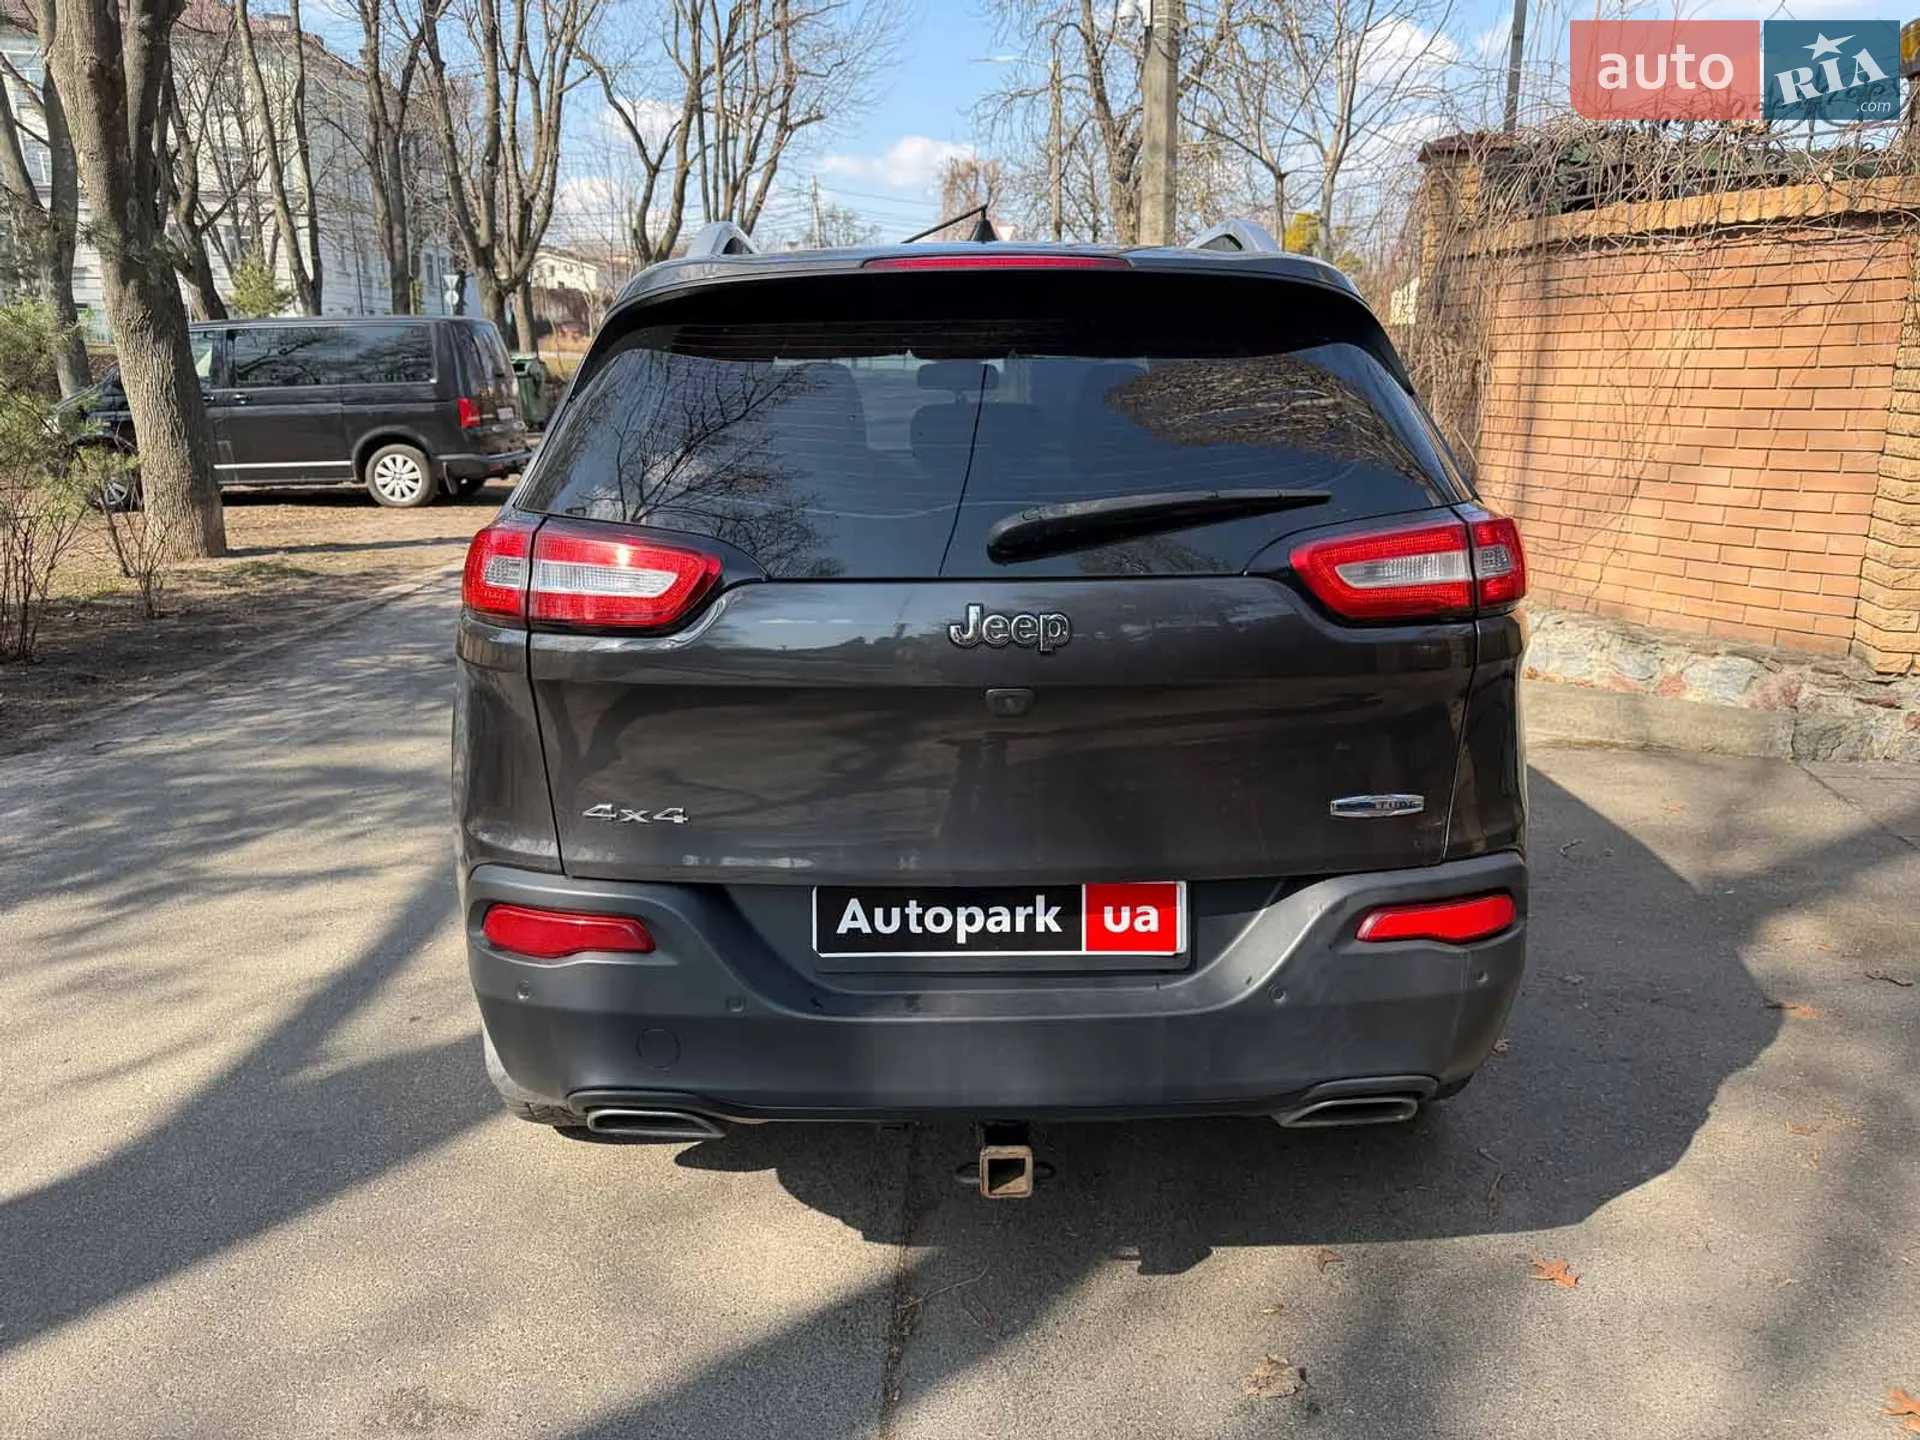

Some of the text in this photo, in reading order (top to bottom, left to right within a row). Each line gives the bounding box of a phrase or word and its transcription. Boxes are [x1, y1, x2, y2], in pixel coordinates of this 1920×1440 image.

[949, 604, 1071, 652] Jeep
[836, 895, 1159, 944] Autopark ua
